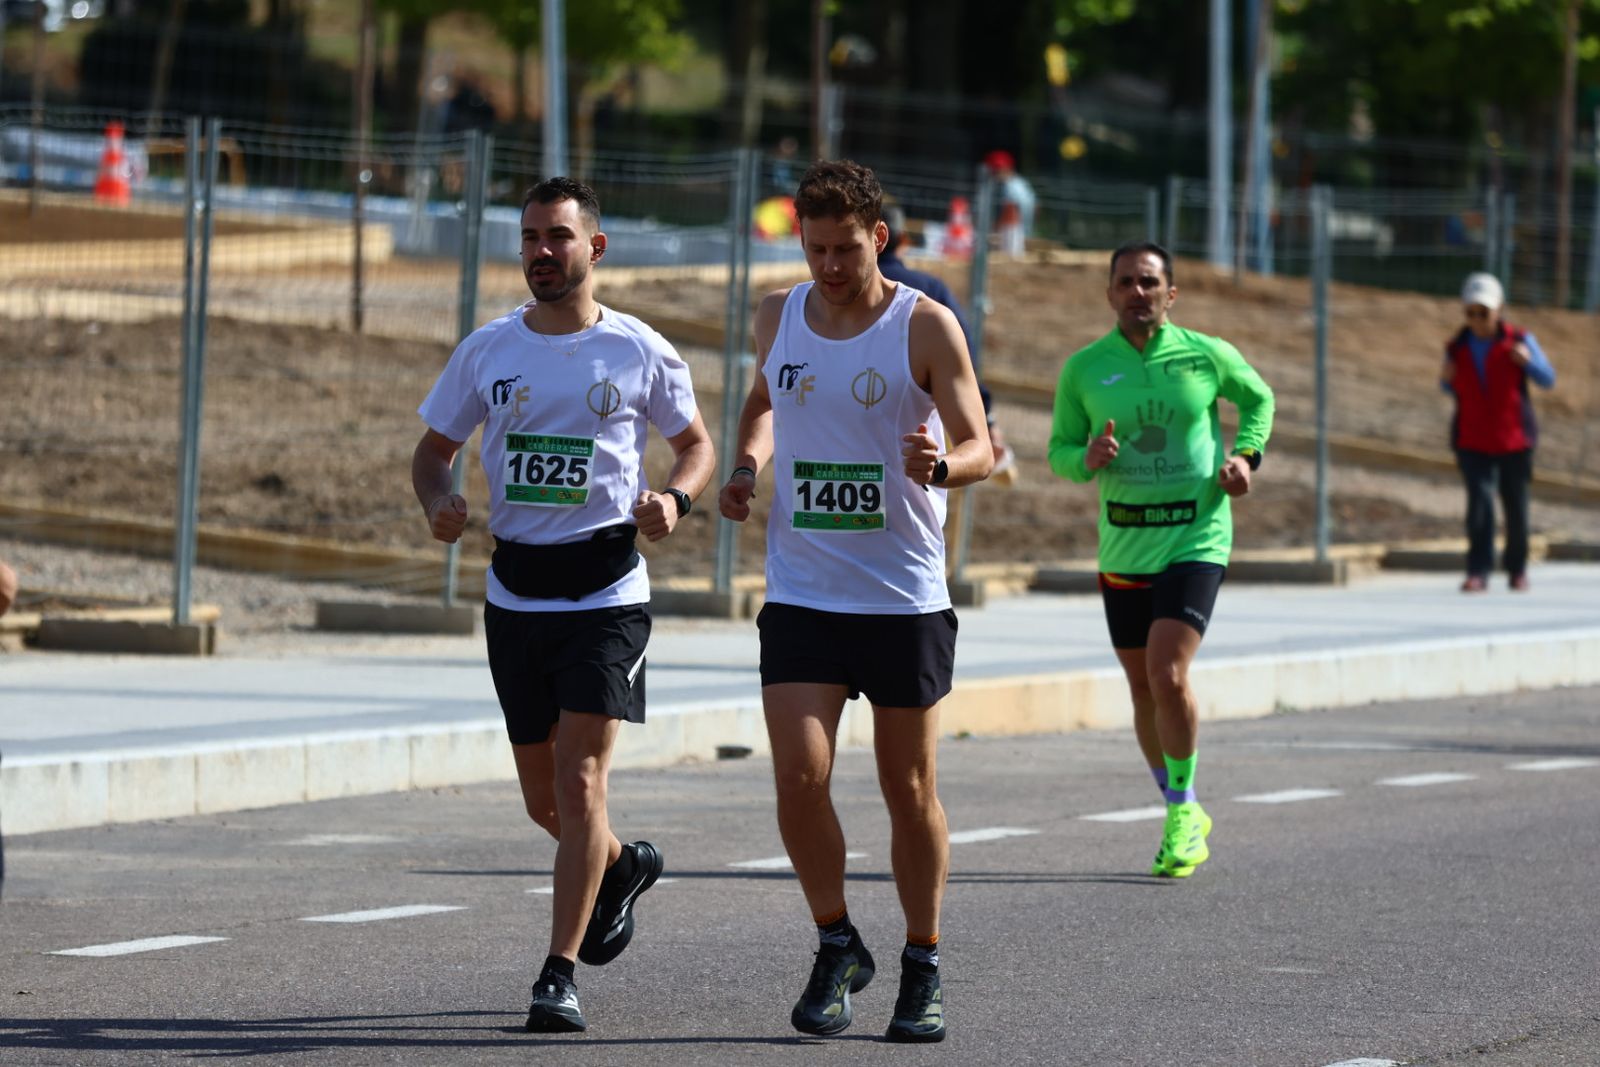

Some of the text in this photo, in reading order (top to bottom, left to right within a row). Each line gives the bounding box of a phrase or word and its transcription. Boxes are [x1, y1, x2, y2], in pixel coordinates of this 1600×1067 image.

[528, 442, 567, 452] CARRERA
[508, 453, 588, 487] 1625
[795, 462, 814, 476] XIV
[816, 470, 858, 480] CARRERA
[797, 481, 880, 512] 1409
